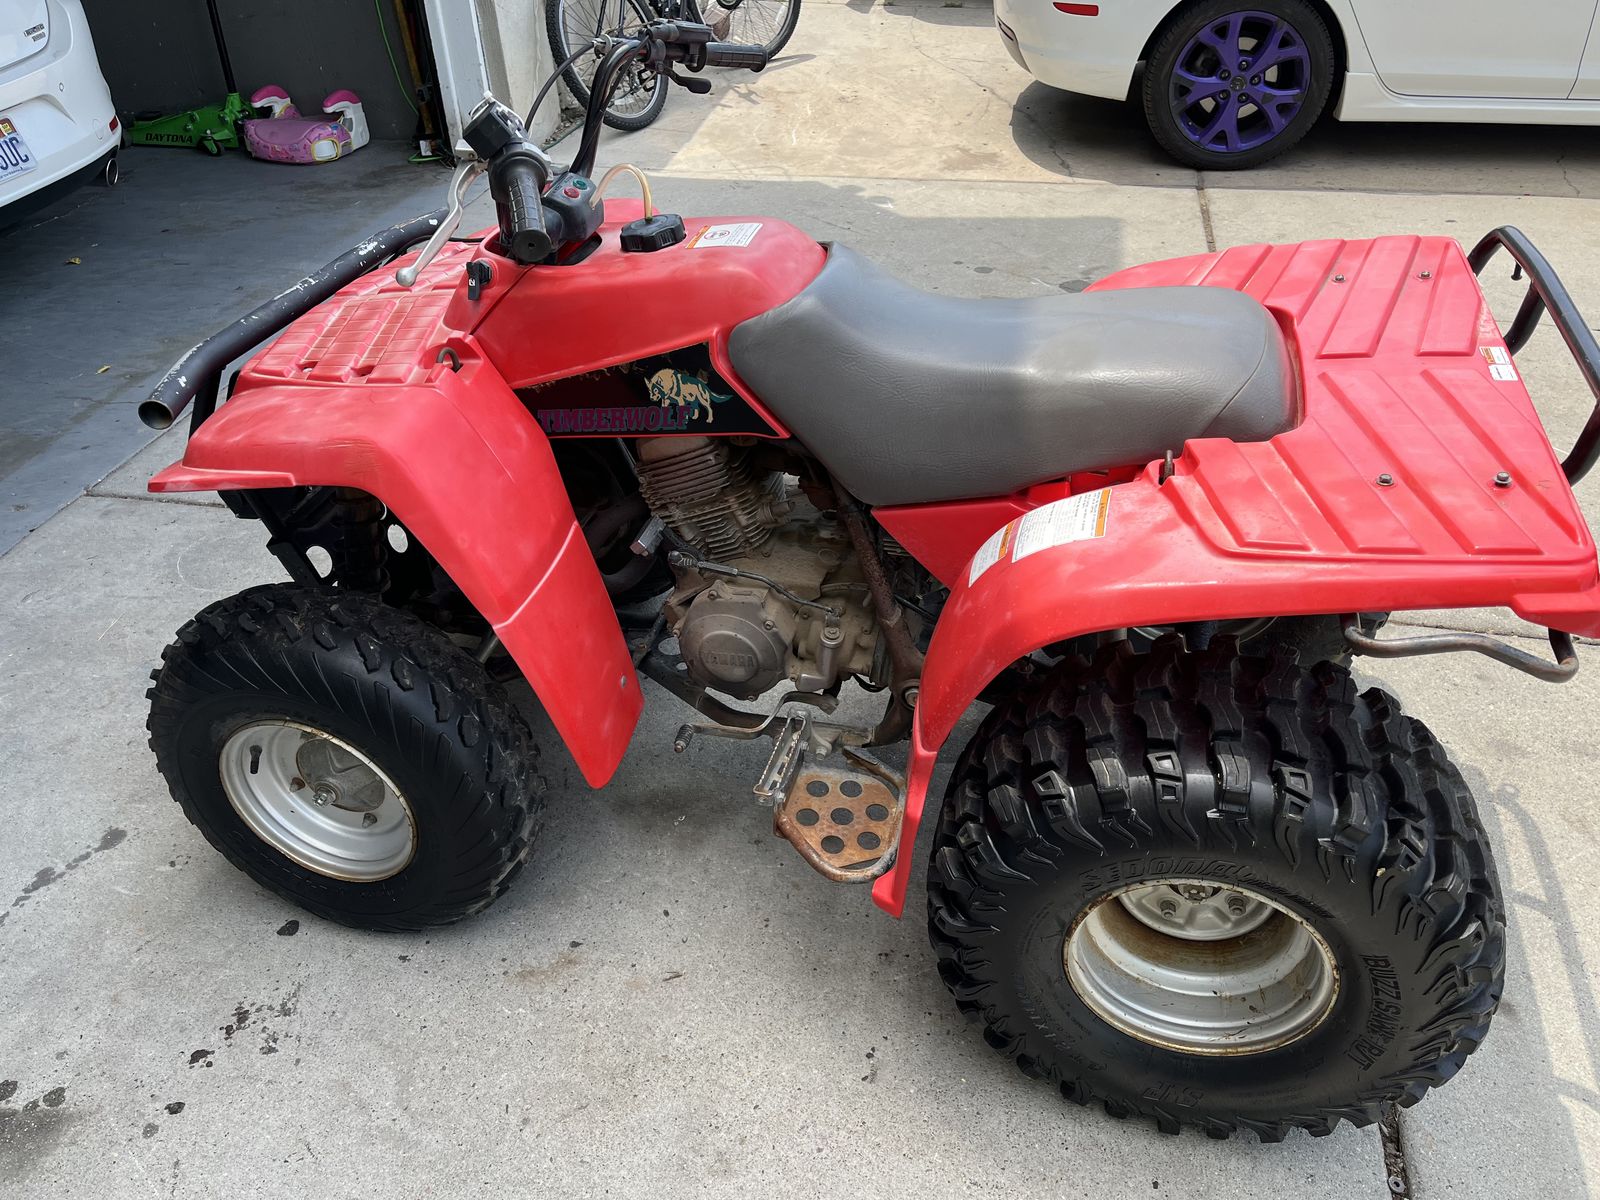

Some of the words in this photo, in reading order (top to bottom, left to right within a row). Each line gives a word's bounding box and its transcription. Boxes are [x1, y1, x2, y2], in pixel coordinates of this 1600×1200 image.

[0, 136, 29, 170] UC
[145, 132, 193, 144] DAYTONA
[537, 405, 691, 433] TIMBERWOLF
[1360, 954, 1402, 1001] BUZZ
